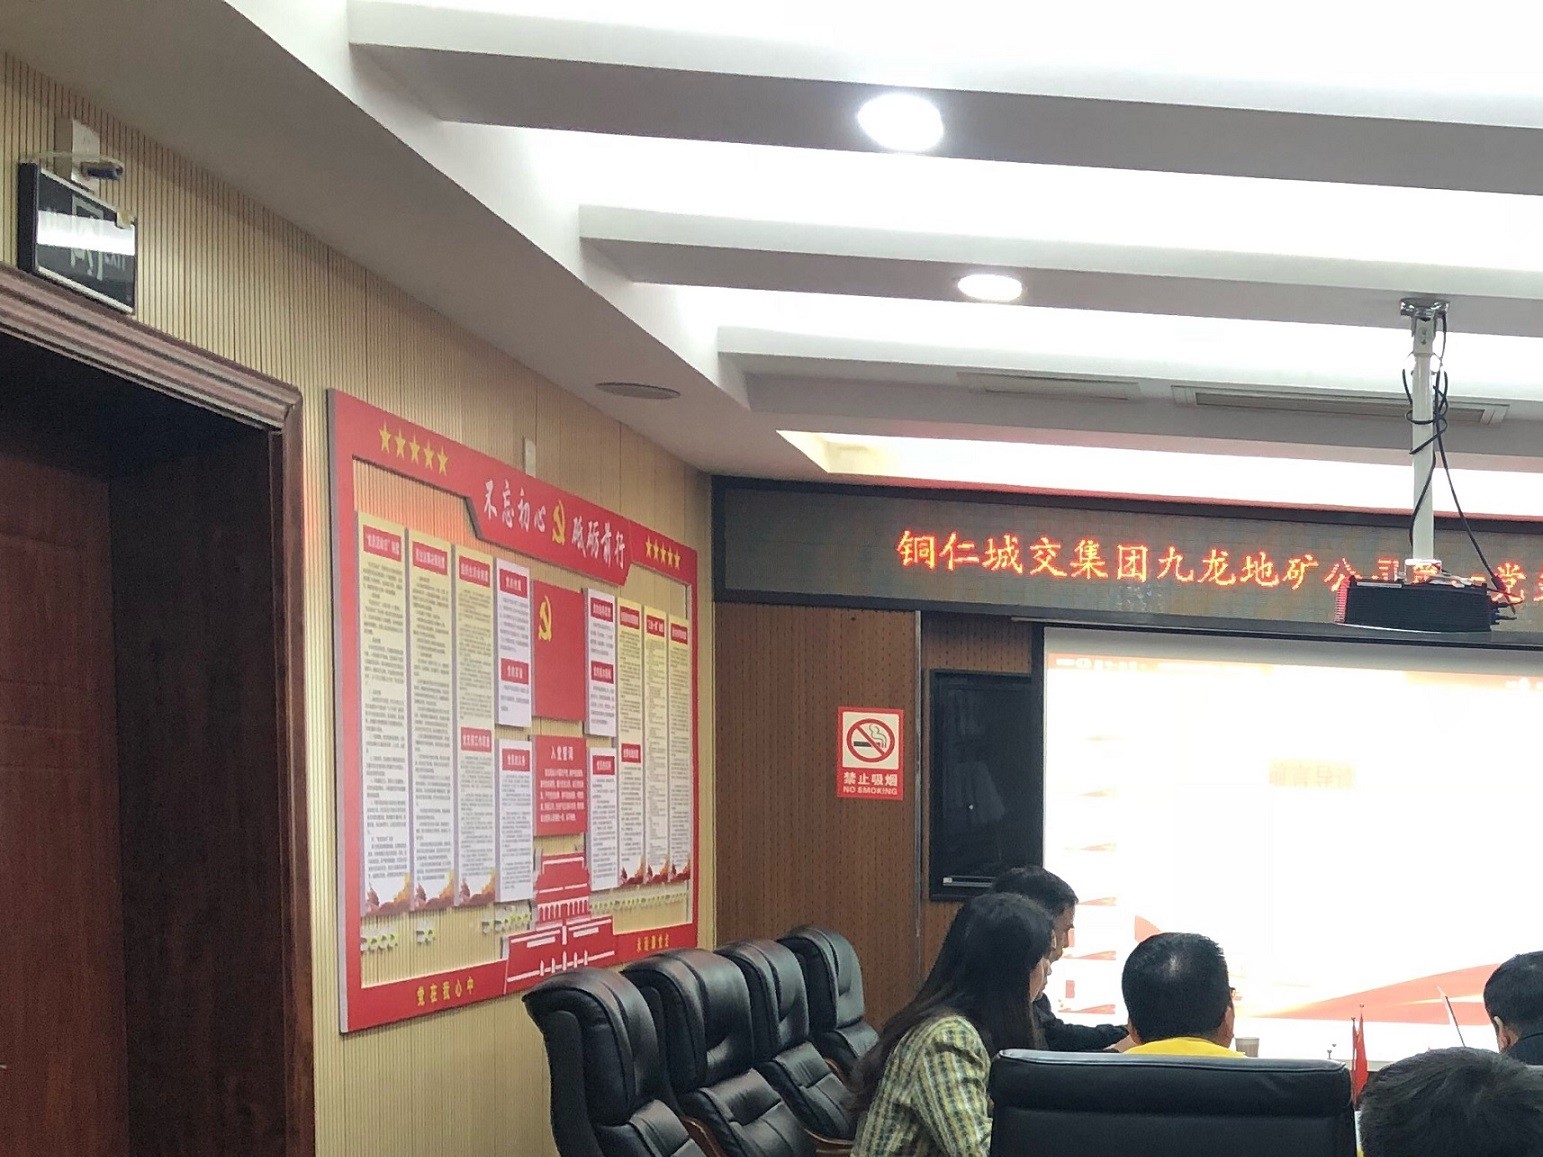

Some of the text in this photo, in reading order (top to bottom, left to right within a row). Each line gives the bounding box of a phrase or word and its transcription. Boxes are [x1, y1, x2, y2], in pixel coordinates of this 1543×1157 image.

[483, 479, 626, 570] 不忘初心 砥砺前行
[843, 771, 898, 787] 禁止吸烟
[857, 786, 898, 795] SMOKING
[416, 975, 475, 1007] 党在我心中
